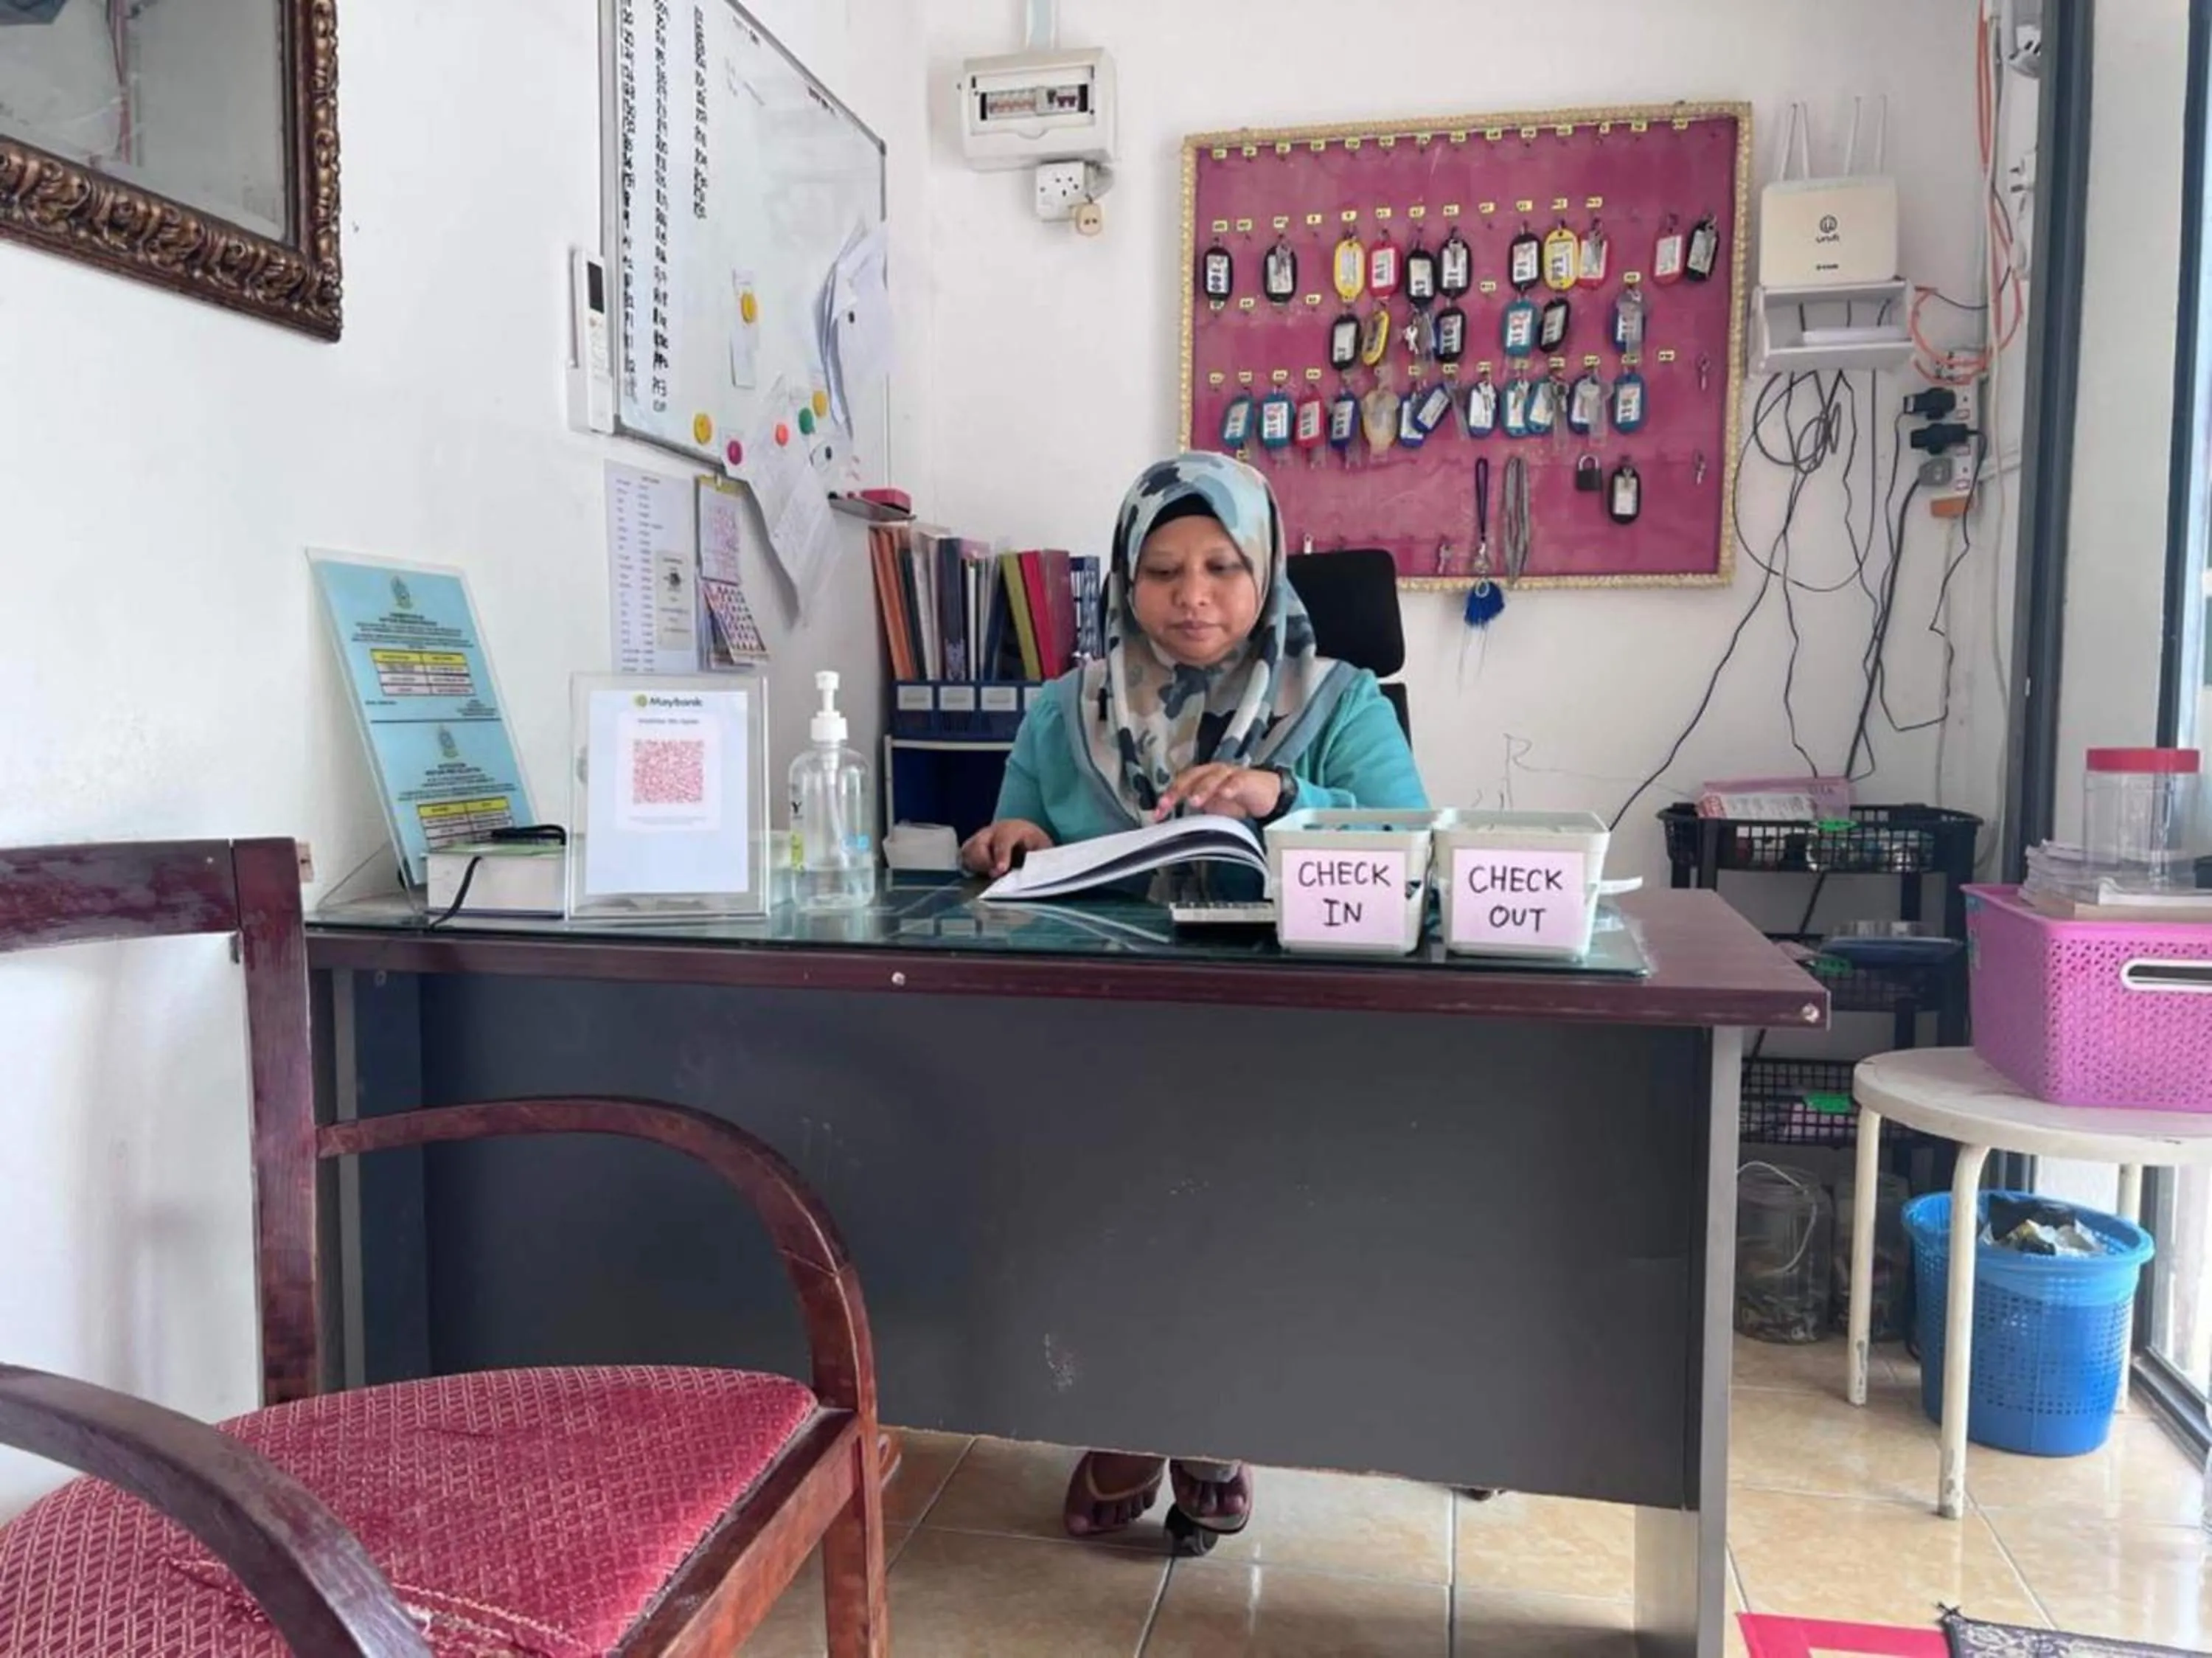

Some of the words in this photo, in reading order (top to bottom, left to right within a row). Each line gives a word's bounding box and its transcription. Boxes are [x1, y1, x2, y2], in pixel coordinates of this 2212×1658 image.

[650, 696, 703, 708] Maybank
[1298, 861, 1391, 887] CHECK
[1469, 865, 1563, 894] CHECK
[1323, 898, 1363, 926] IN
[1489, 905, 1547, 932] OUT
